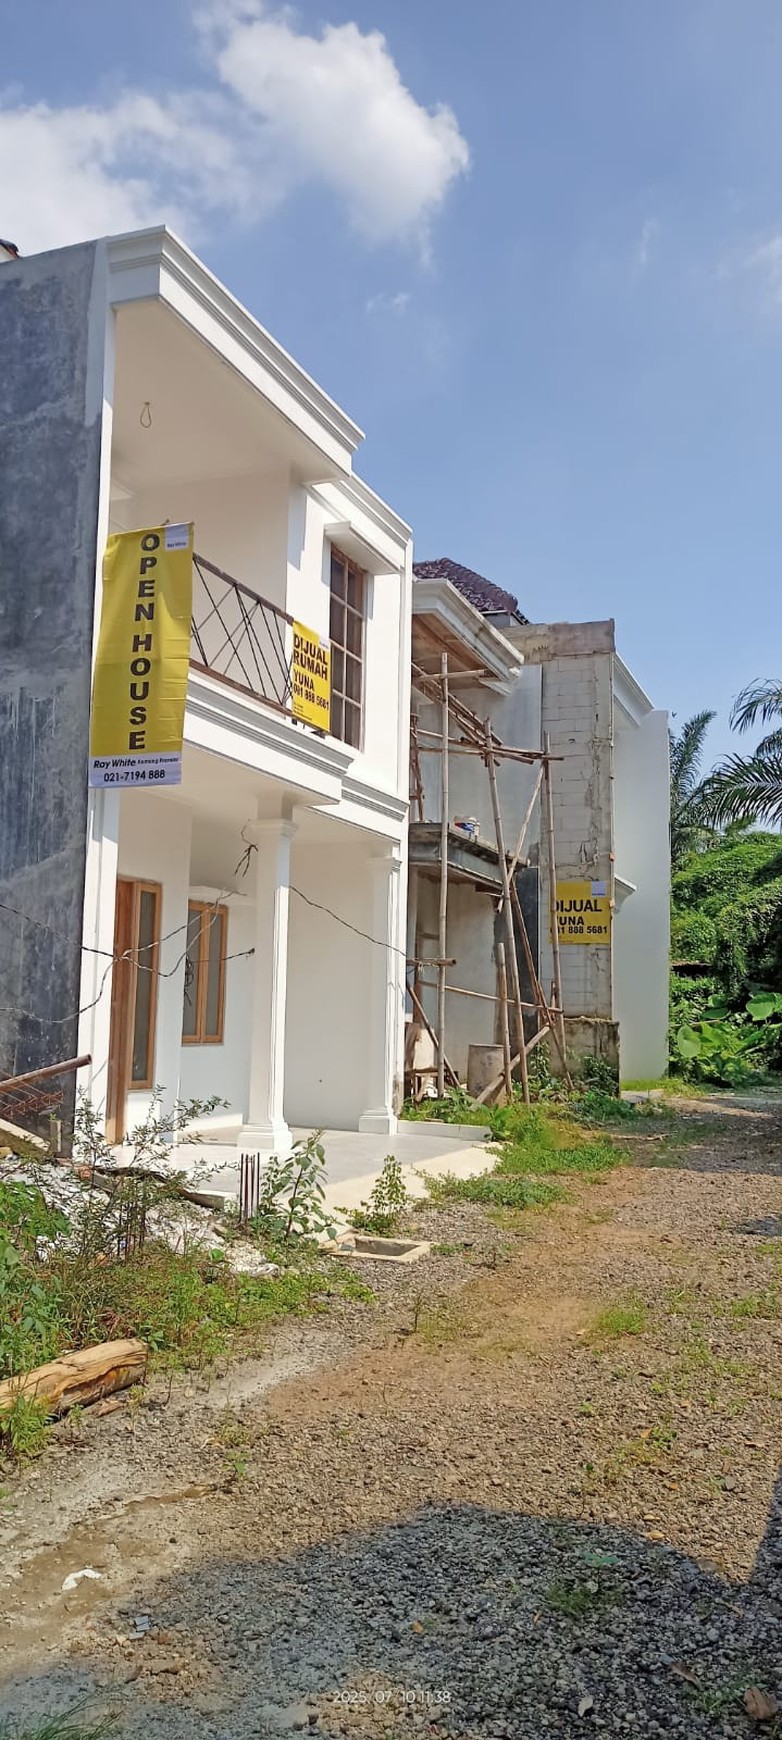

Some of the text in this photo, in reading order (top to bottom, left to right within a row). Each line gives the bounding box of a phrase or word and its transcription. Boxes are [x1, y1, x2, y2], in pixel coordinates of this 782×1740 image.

[128, 533, 160, 750] OPEN HOUSE
[293, 633, 328, 666] DIJUAL
[293, 648, 328, 681] RUMAH
[293, 668, 315, 690] YUNA
[93, 760, 111, 769] Ray
[111, 758, 136, 767] White
[103, 769, 166, 782] 021-7194 888
[556, 916, 585, 926] UNA
[586, 925, 608, 934] 5681
